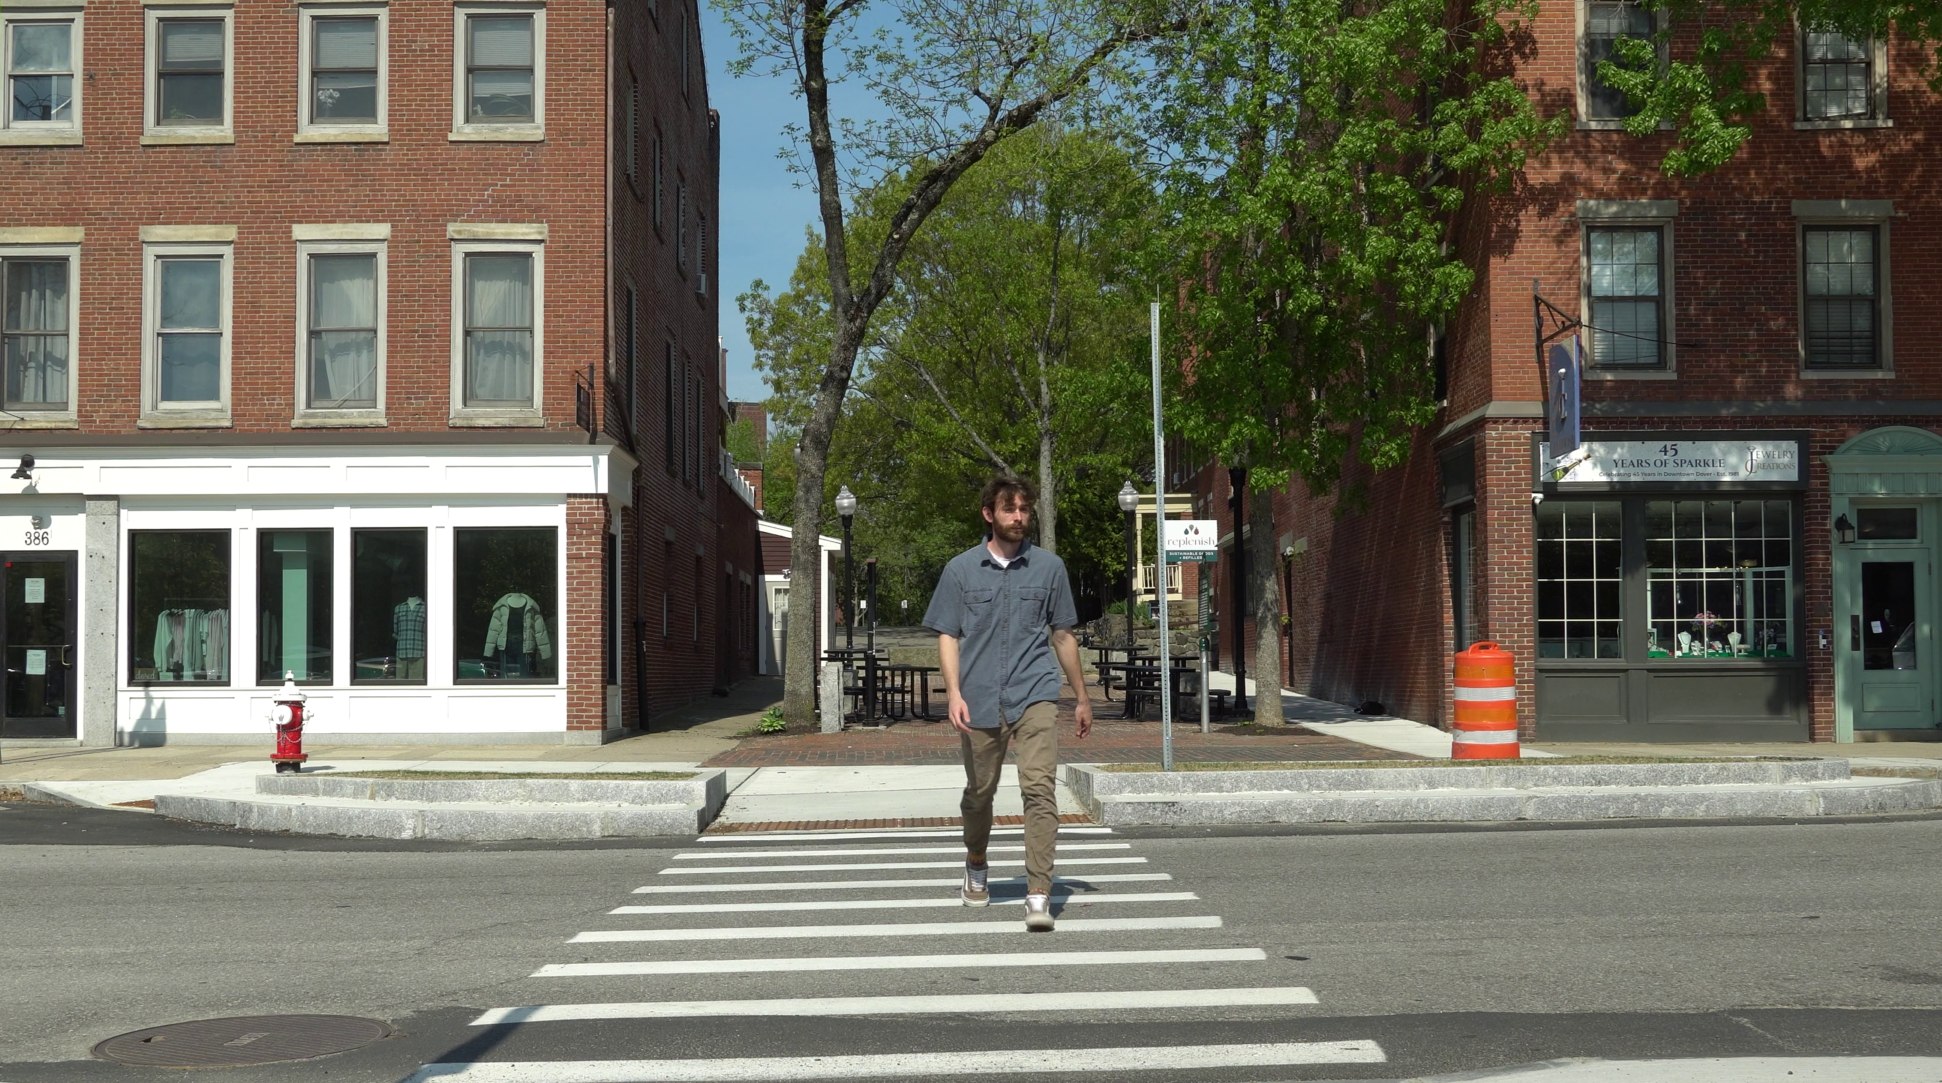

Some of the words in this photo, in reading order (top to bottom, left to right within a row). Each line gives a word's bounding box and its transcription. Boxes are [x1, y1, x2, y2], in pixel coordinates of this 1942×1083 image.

[1659, 443, 1678, 457] 45
[1613, 459, 1651, 468] YEARS
[1653, 459, 1669, 468] OF
[1673, 459, 1726, 468] SPARKLE
[1745, 459, 1796, 473] CREATIONS
[25, 531, 49, 545] 386
[1167, 537, 1215, 548] replenish
